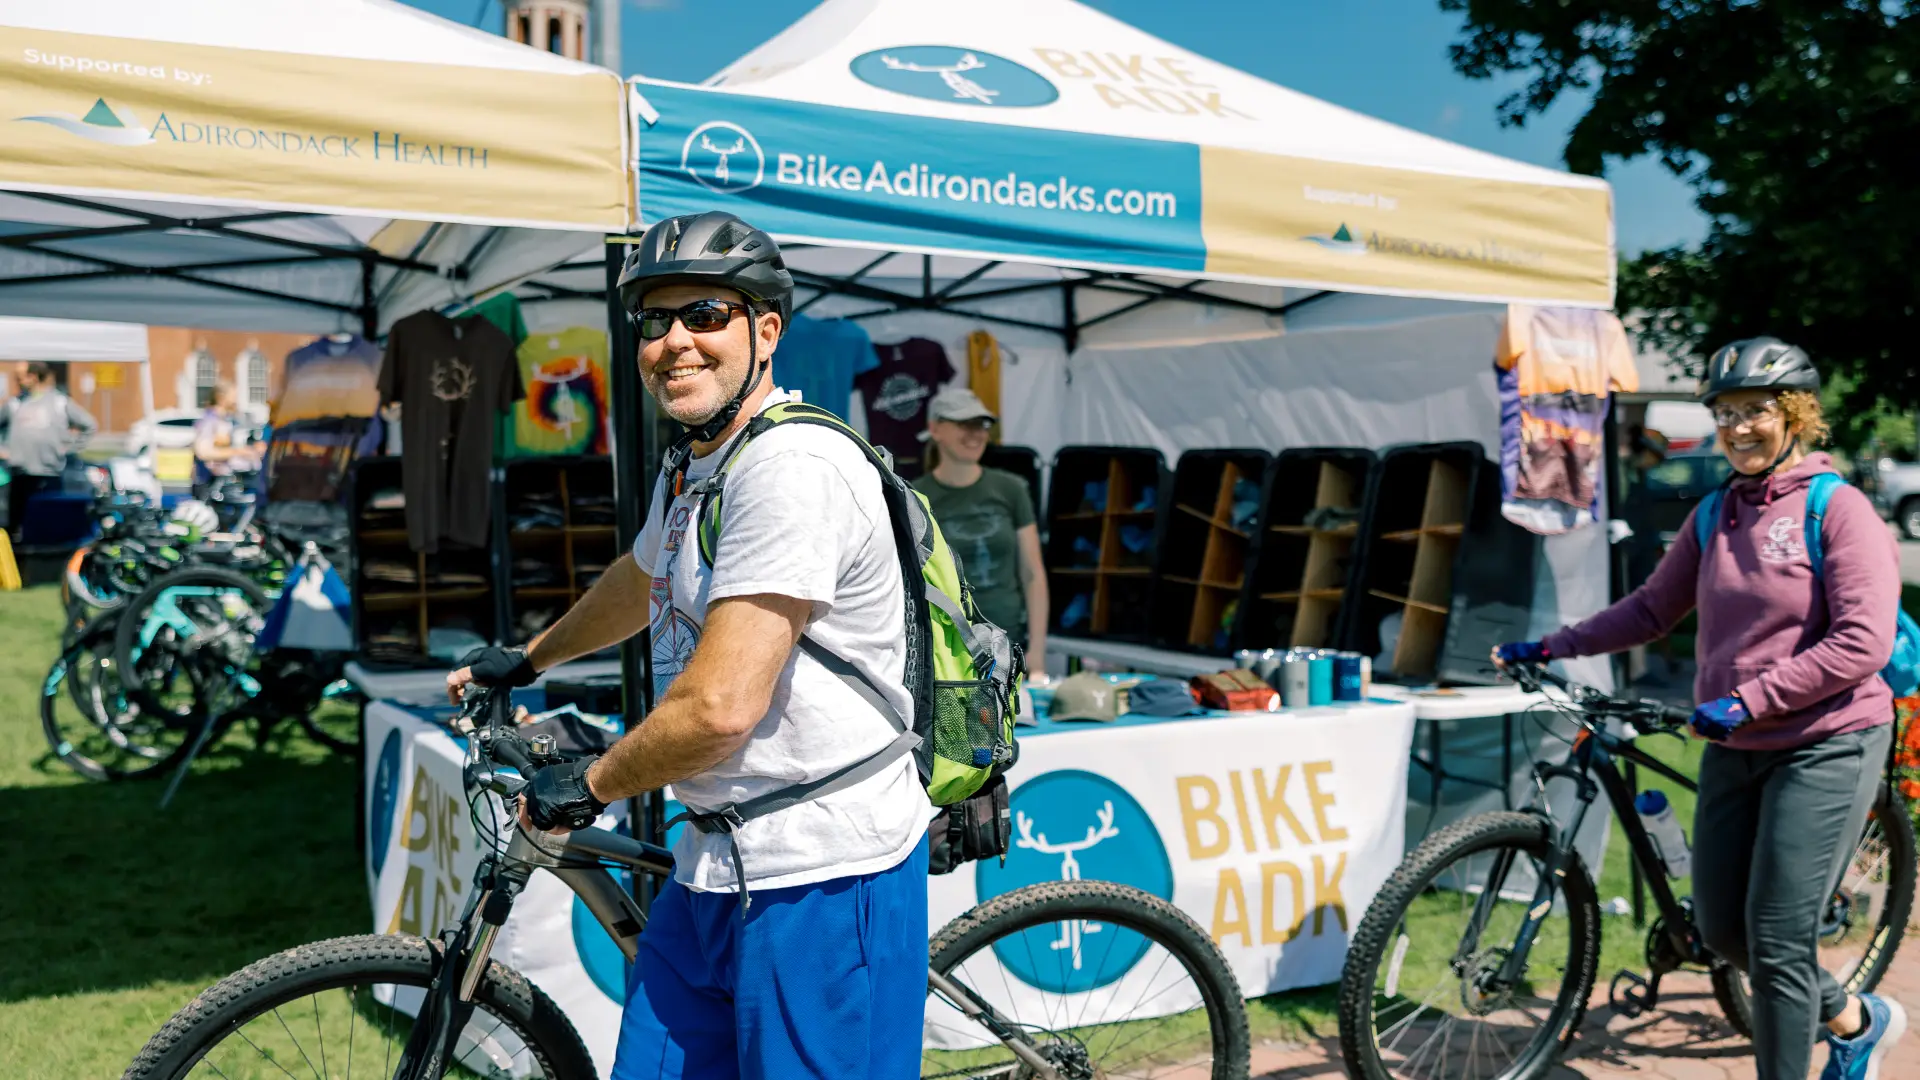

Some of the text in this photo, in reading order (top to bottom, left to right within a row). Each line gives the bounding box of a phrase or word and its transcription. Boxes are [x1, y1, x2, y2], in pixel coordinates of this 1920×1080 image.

[24, 48, 212, 85] Supported by:
[1030, 48, 1218, 88] BIKE
[1093, 83, 1259, 120] ADK
[149, 111, 488, 168] ADIRONDACK HEALTH
[776, 153, 1177, 218] BikeAdirondacks.com
[1176, 760, 1349, 860] BIKE
[1210, 852, 1348, 948] ADK
